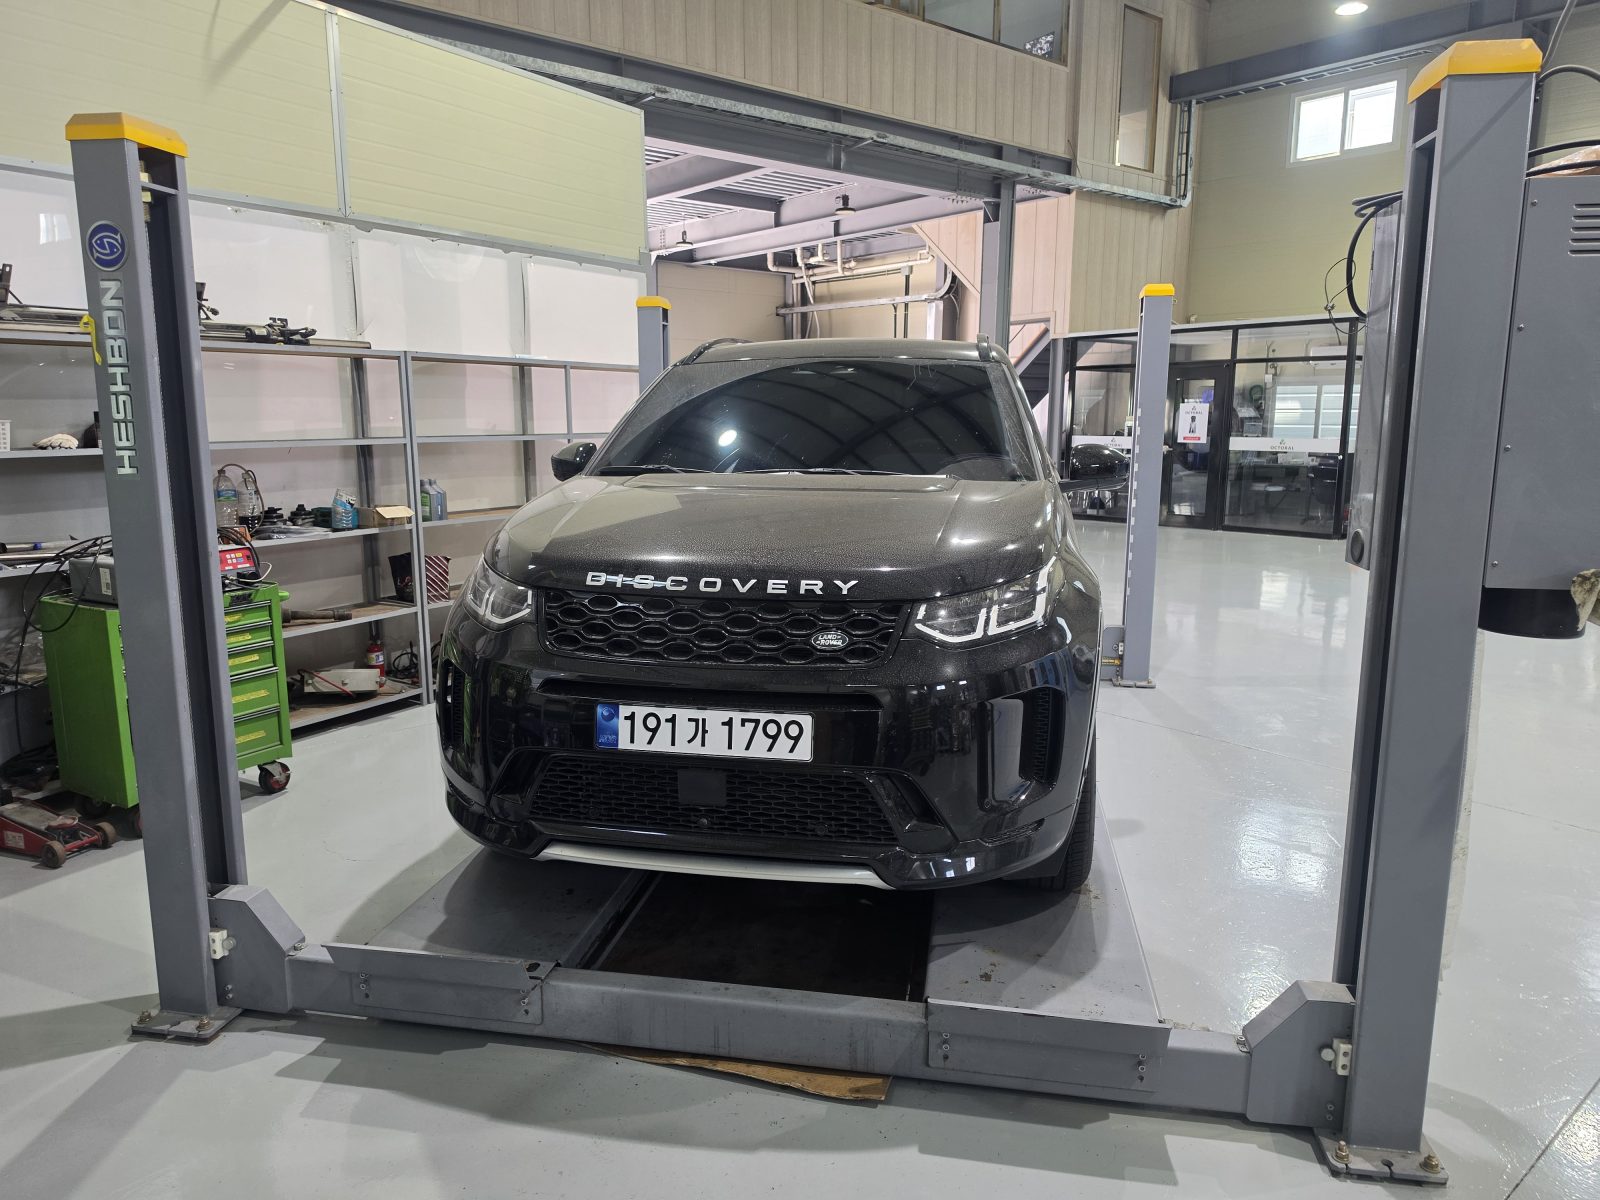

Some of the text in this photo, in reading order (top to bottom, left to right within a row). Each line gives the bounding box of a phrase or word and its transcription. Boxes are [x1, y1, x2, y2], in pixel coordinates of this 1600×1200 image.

[100, 280, 138, 475] HESHBON
[585, 571, 859, 595] DISCOVERY
[623, 711, 804, 754] 191가 1799
